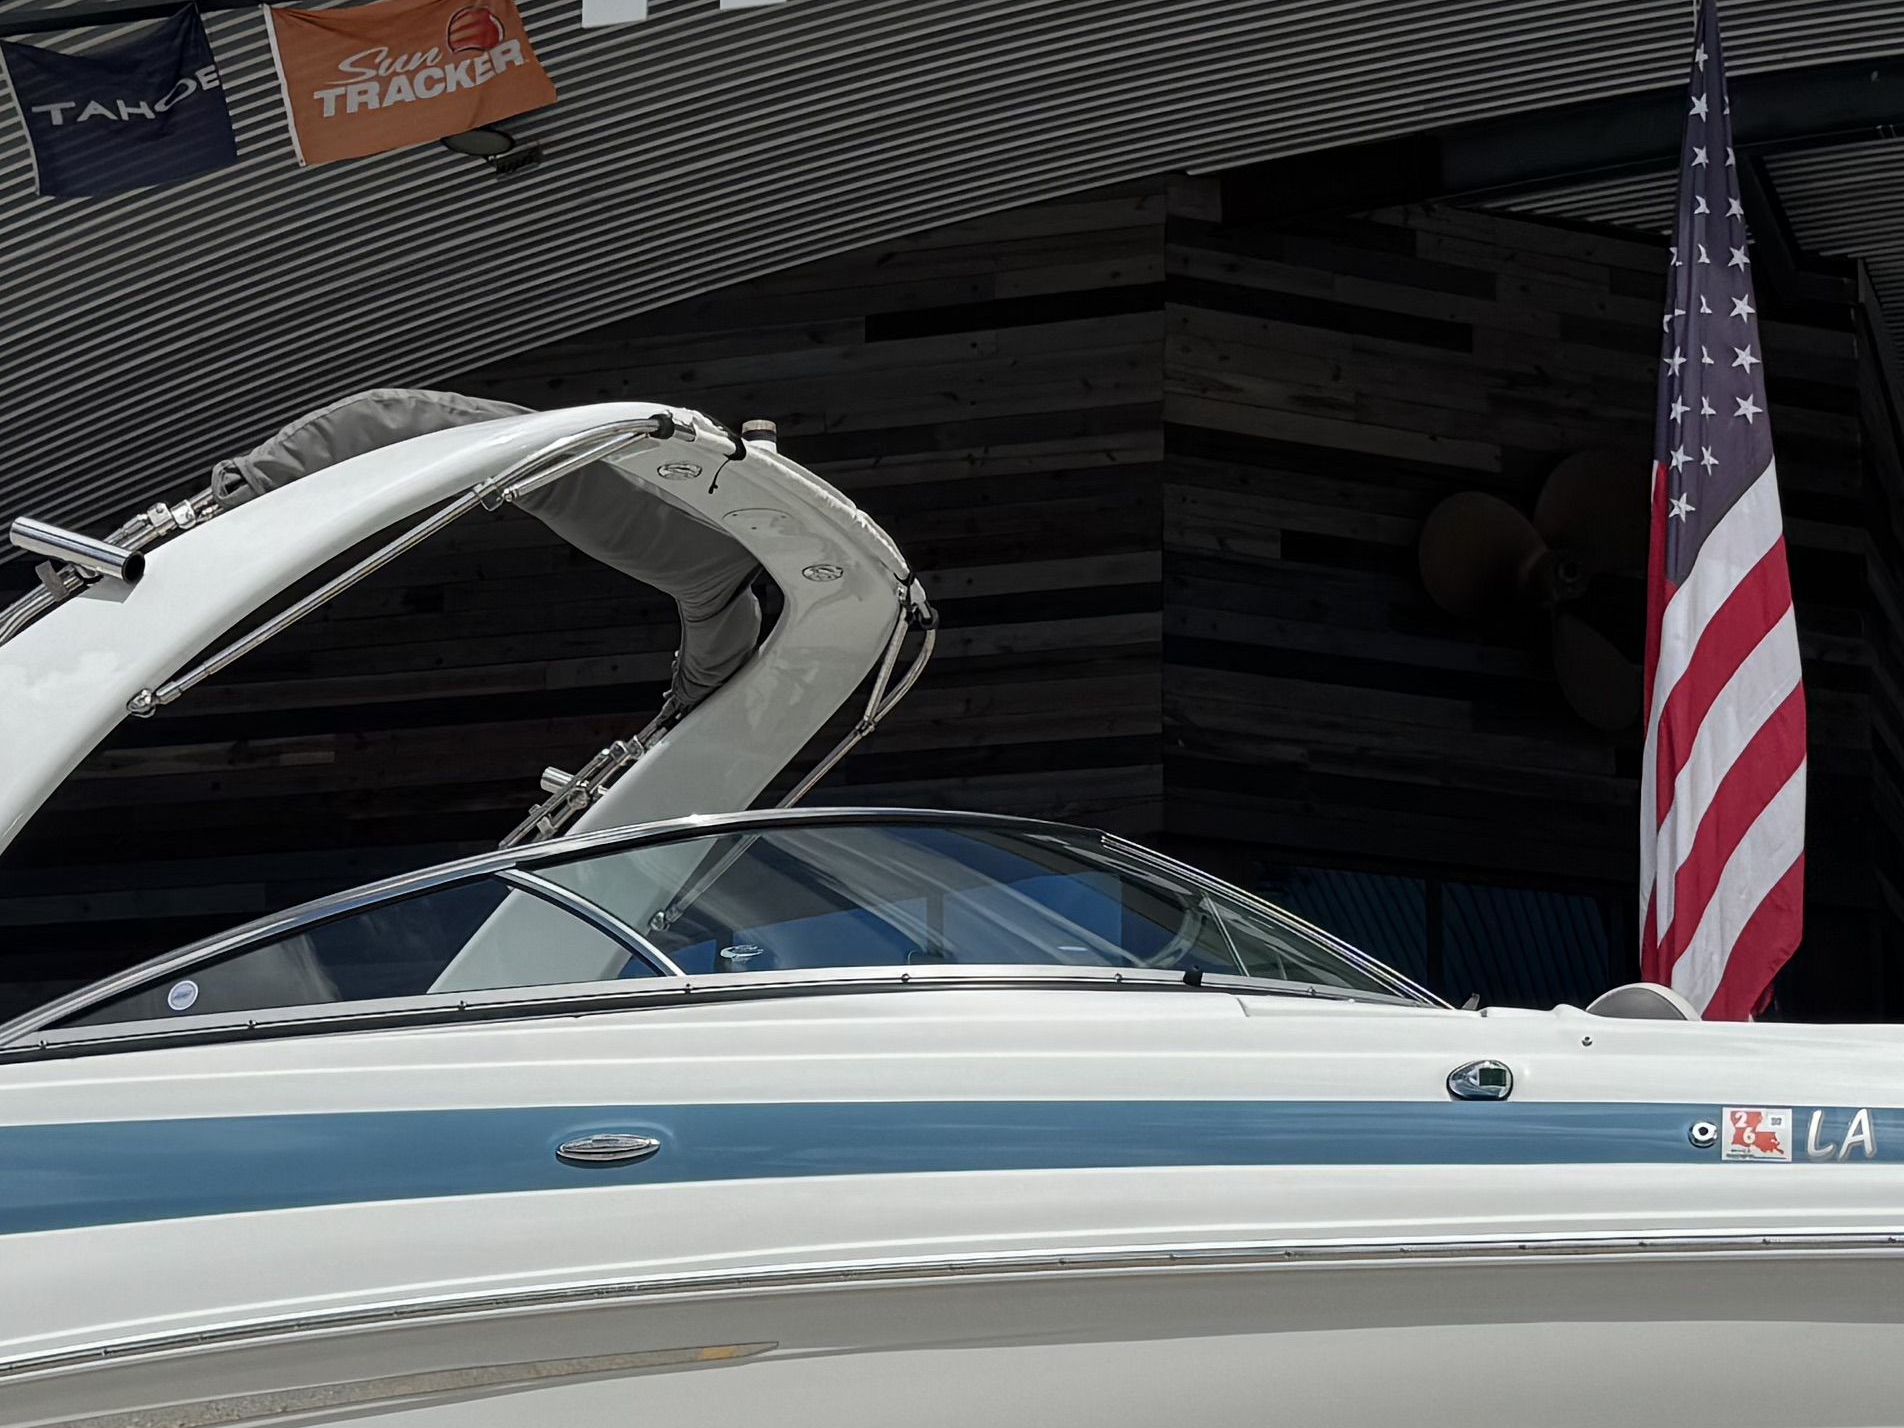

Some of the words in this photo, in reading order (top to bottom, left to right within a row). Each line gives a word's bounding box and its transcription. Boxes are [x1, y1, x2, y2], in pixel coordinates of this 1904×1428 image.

[31, 63, 221, 126] TAHOE
[313, 38, 525, 118] TRACKER
[324, 47, 442, 85] Sun
[1807, 1108, 1877, 1162] LA
